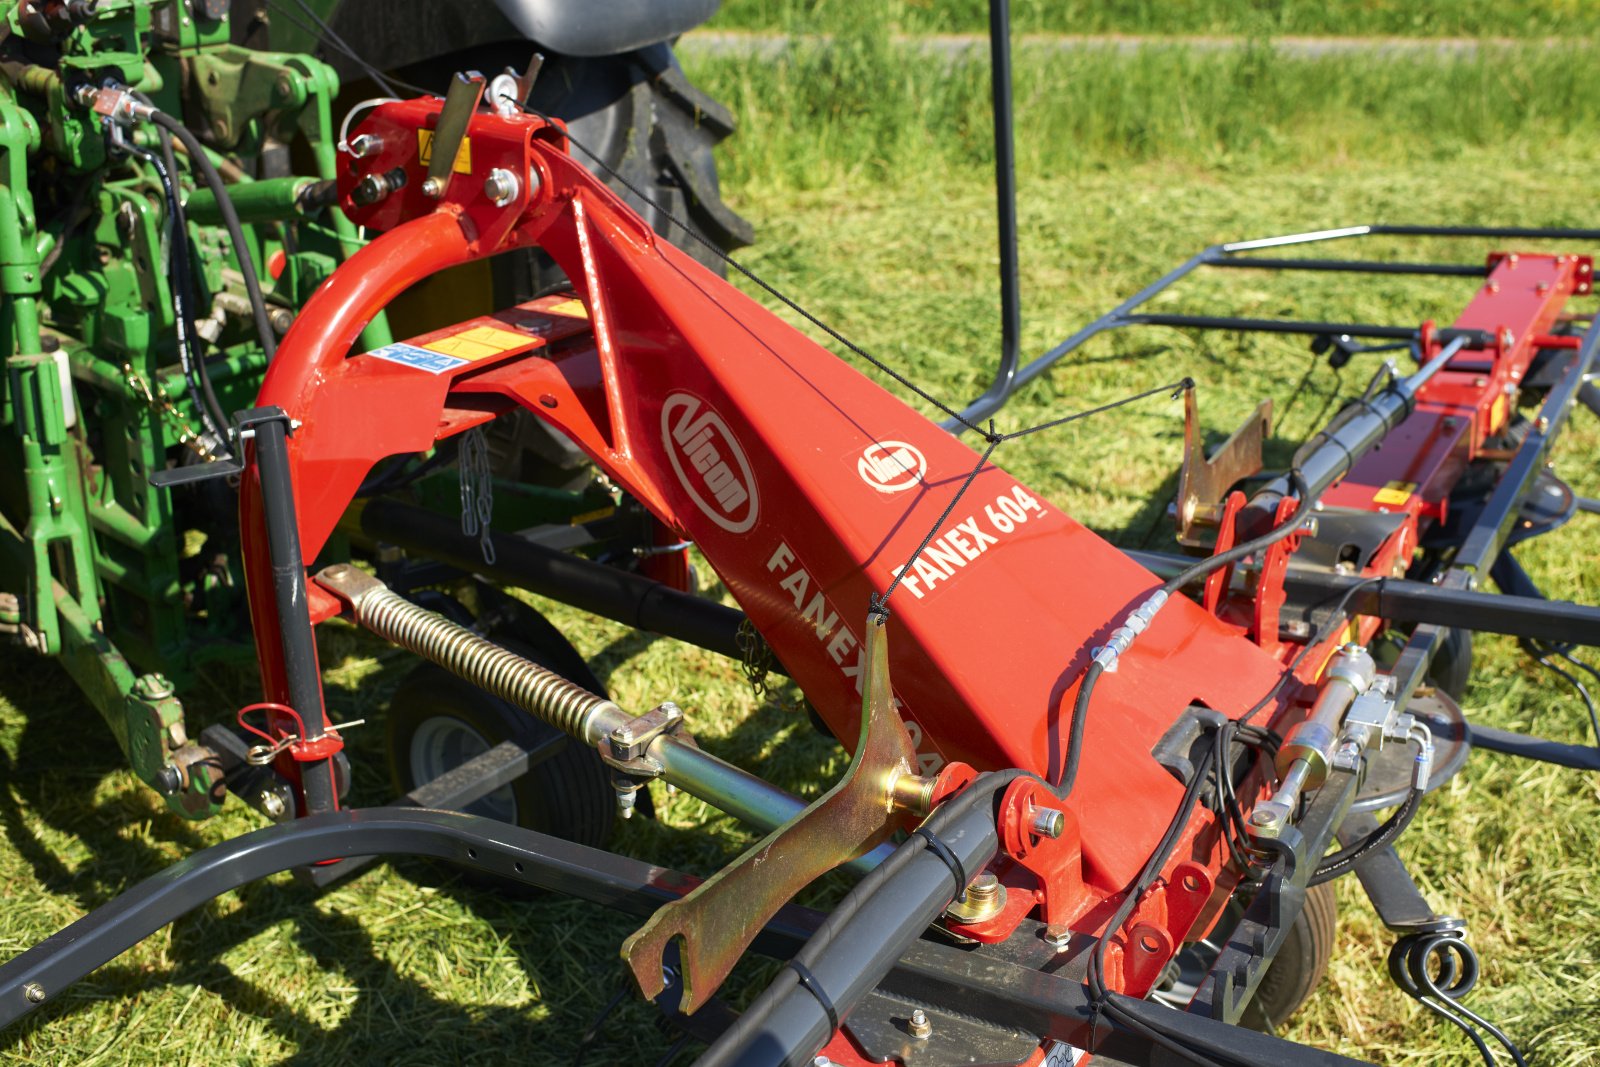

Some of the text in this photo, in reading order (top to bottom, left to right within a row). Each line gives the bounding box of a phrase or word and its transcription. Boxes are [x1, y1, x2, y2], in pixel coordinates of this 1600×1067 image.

[661, 393, 759, 534] Vicon
[858, 440, 927, 492] Vicon
[891, 485, 1042, 599] FANEX 604
[767, 541, 865, 697] FANEX
